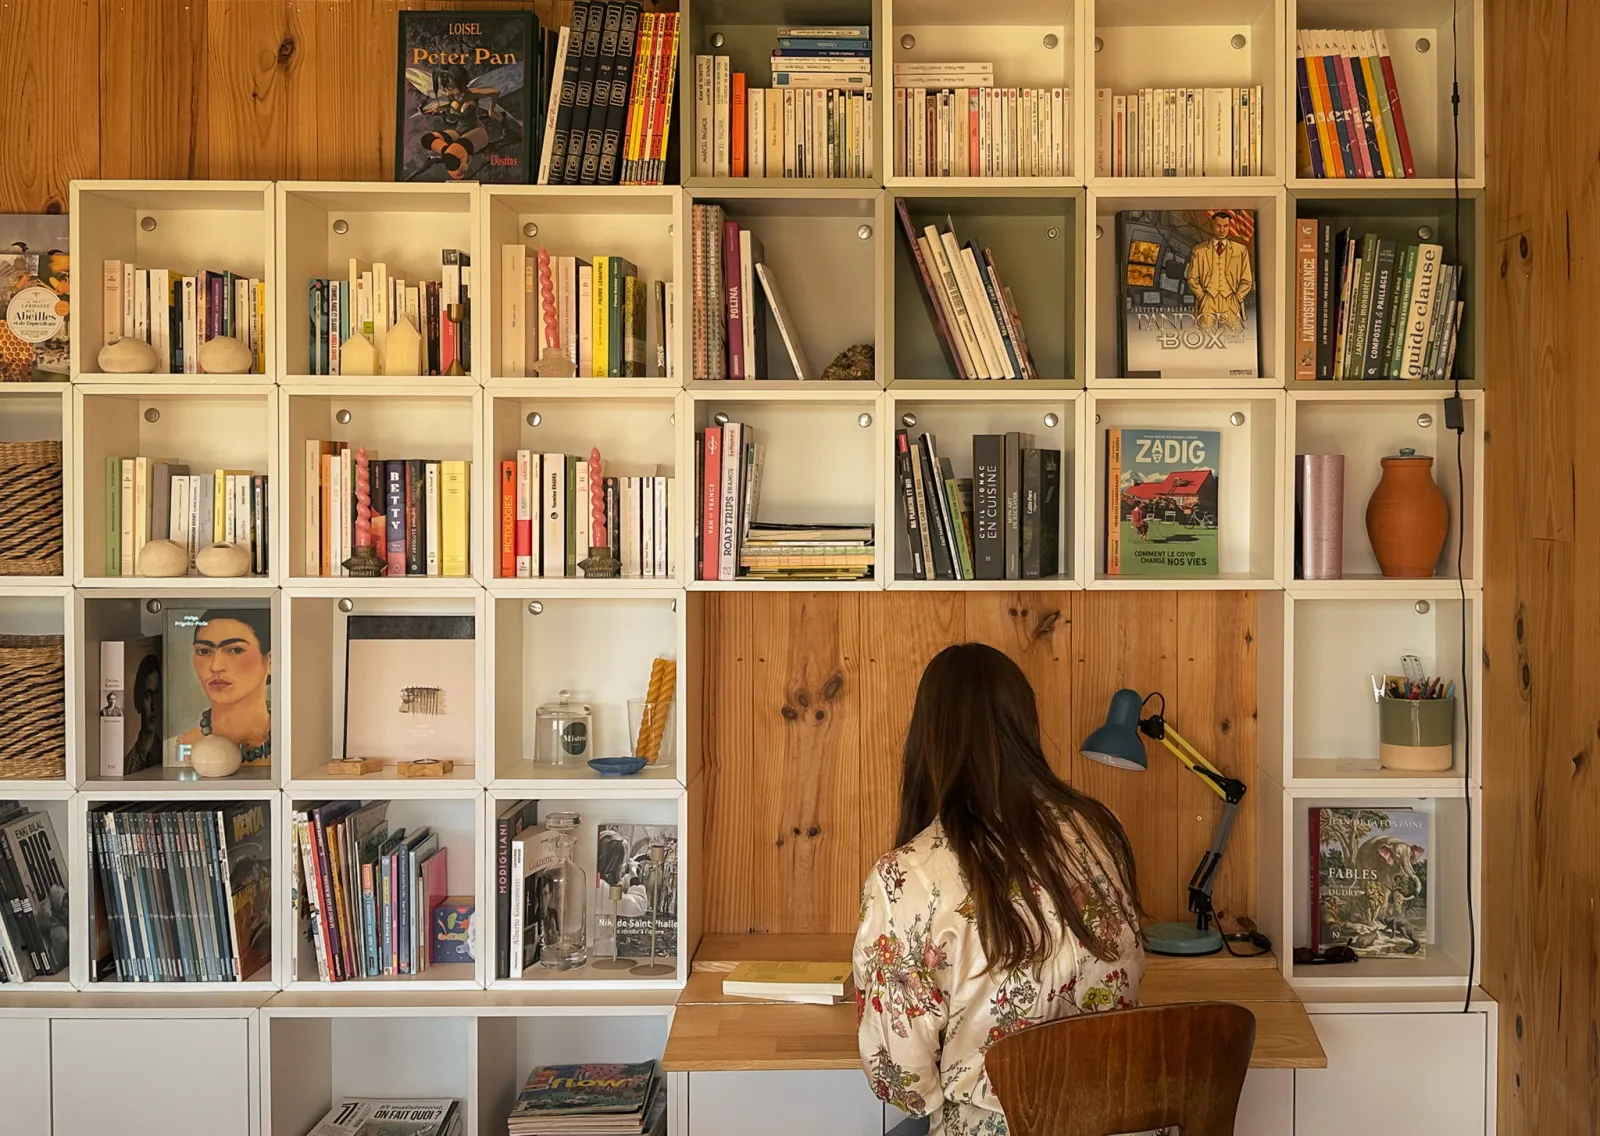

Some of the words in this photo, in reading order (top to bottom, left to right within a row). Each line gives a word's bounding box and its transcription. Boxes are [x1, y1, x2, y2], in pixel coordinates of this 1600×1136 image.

[449, 23, 482, 35] LOISEL
[412, 48, 469, 65] Peter
[474, 48, 517, 64] Pan
[491, 154, 518, 166] Destins
[986, 283, 998, 301] Jean
[1414, 249, 1435, 317] clause
[729, 286, 739, 319] POLINA
[1302, 258, 1315, 342] L'AUTOSUFFISANCE
[13, 312, 56, 321] Abeilles
[993, 302, 1008, 336] Monsieur
[1371, 319, 1382, 359] COMPOSTS
[1377, 270, 1388, 310] PAILLAGES
[1157, 330, 1226, 350] BOX
[1355, 325, 1365, 356] JARDINS
[1386, 327, 1395, 349] Potager
[1407, 321, 1425, 376] guide
[1135, 439, 1206, 464] ZADIG
[390, 472, 400, 529] BETTY
[987, 465, 997, 517] CUISINE
[724, 496, 733, 525] TRIPS
[918, 499, 926, 522] CABANES
[936, 516, 944, 534] MAISON
[987, 522, 997, 539] EN
[1012, 521, 1017, 529] DE
[723, 527, 732, 556] ROAD
[1168, 558, 1185, 566] NOS
[15, 826, 28, 839] ENKI
[28, 820, 44, 834] BILAL
[499, 824, 507, 894] MODIGLIANI
[1328, 868, 1378, 880] FABLES
[11, 898, 23, 913] BUG
[20, 898, 33, 912] BUG
[617, 919, 627, 927] de
[628, 919, 653, 928] Saint
[550, 1077, 630, 1089] flow
[374, 1110, 388, 1118] ON
[389, 1111, 411, 1119] FAIT
[411, 1111, 434, 1120] QUOI
[435, 1111, 442, 1120] ?
